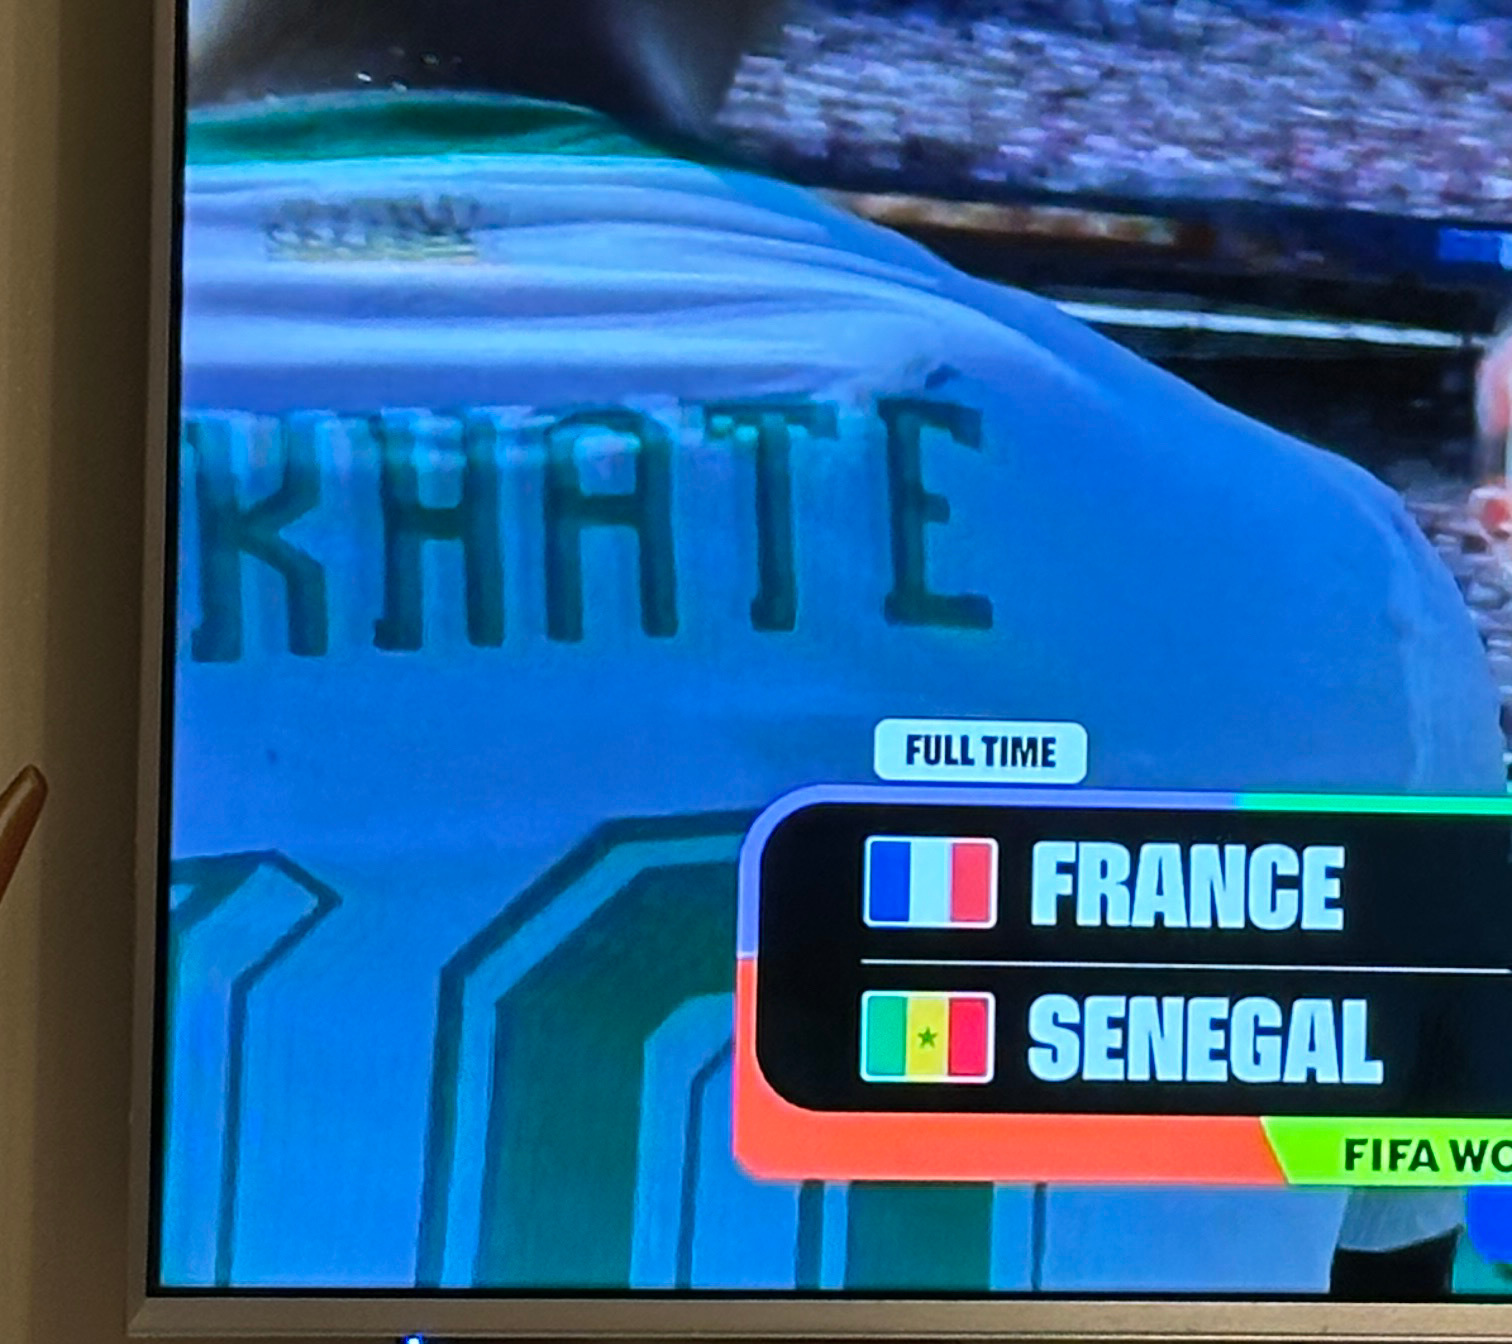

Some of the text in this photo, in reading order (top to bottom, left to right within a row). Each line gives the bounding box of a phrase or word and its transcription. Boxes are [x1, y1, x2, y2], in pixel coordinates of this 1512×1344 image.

[906, 734, 1057, 768] FULL TIME
[1030, 840, 1346, 932] FRANCE
[1027, 994, 1385, 1085] SENEGAL
[1344, 1138, 1440, 1172] FIFA
